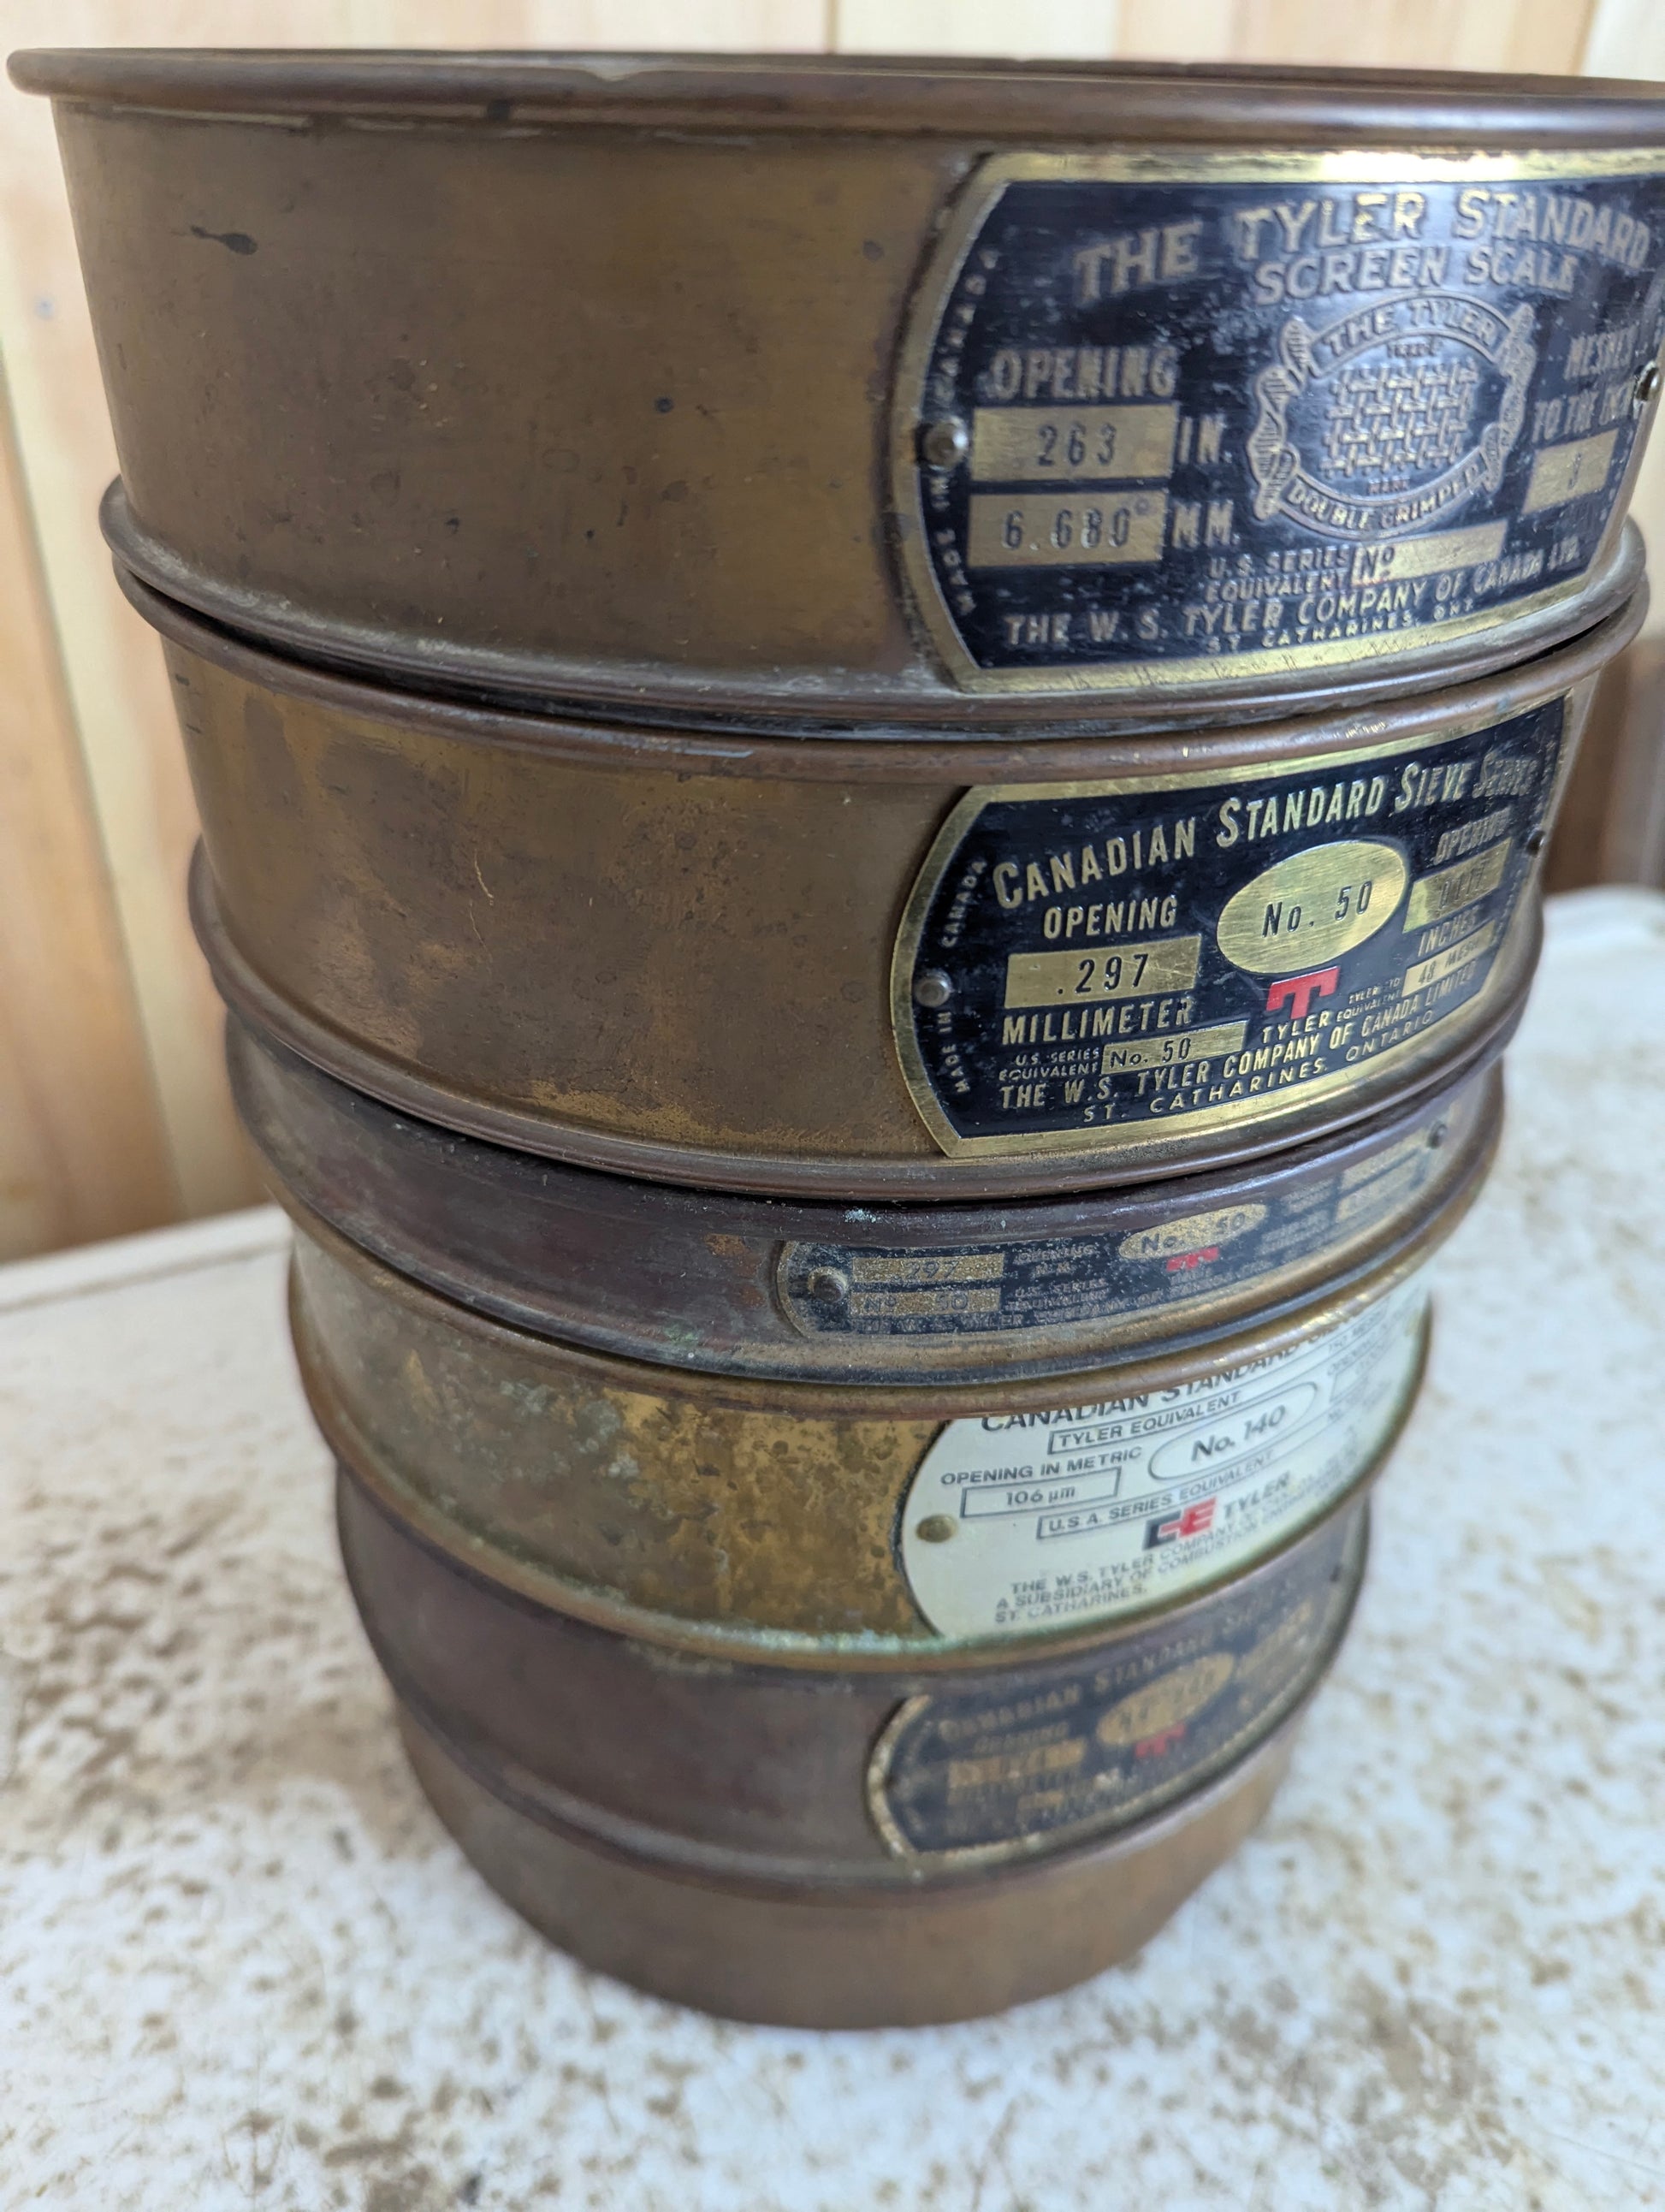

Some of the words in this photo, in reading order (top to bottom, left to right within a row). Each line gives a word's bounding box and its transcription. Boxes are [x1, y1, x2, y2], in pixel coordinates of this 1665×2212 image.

[1072, 218, 1204, 305] THE
[1235, 190, 1426, 259] TYLER
[1454, 187, 1652, 270] STANDARD
[1254, 245, 1452, 307] SCREEN
[1464, 245, 1579, 294] SCALE
[1329, 306, 1395, 358] THE
[1407, 299, 1499, 347] TYLER
[989, 347, 1179, 400] OPENING
[1037, 422, 1118, 467] 263
[1286, 484, 1376, 531] DOUBLE
[1265, 543, 1351, 575] SERIES
[1003, 611, 1071, 646] THE
[1182, 596, 1284, 638] TYLER
[1297, 578, 1428, 626] COMPANY
[1435, 571, 1467, 602] OF
[1205, 566, 1349, 603] EQUIVALENT
[992, 815, 1196, 910] CANADIAN
[1216, 774, 1387, 849] STANDARD
[1394, 760, 1476, 814] SIEVE
[940, 859, 988, 949] CANADA
[1043, 893, 1179, 940] OPENING
[1260, 900, 1315, 940] No.
[1334, 880, 1373, 922] 50
[1417, 904, 1481, 958] INCHES
[1056, 952, 1150, 996] .297
[1417, 959, 1438, 986] 48
[998, 1082, 1048, 1110] THE
[1137, 1061, 1209, 1099] TYLER
[1223, 1031, 1324, 1079] COMPANY
[1329, 1024, 1354, 1051] OF
[1360, 994, 1421, 1038] CANADA
[1424, 958, 1478, 1008] LIMITED
[1002, 996, 1194, 1047] MILLIMETER
[1261, 1009, 1330, 1045] TYLER
[1345, 1008, 1436, 1064] ONTARIO
[998, 1062, 1100, 1083] EQUIVALENT
[1049, 1046, 1100, 1064] SERIES
[1109, 1048, 1149, 1067] No.
[1160, 1036, 1192, 1064] 50
[981, 1394, 1150, 1433] CANADIAN
[1059, 1423, 1123, 1448] TYLER
[1129, 1389, 1241, 1435] EQUIVALENT
[1190, 1435, 1236, 1462] No.
[1243, 1403, 1287, 1441] 140
[940, 1464, 1034, 1486] OPENING
[1040, 1461, 1060, 1476] IN
[1067, 1445, 1143, 1473] METRIC
[1108, 1493, 1173, 1521] SERIES
[1177, 1450, 1274, 1502] EQUIVALENT
[1006, 1487, 1044, 1507] 106
[1223, 1468, 1292, 1518] TYLER
[1010, 1577, 1047, 1595] THE
[1099, 1552, 1156, 1581] TYLER
[1160, 1527, 1235, 1560] COMPANY
[996, 1597, 1009, 1610] A
[1014, 1577, 1123, 1608] SUBSIDIARY
